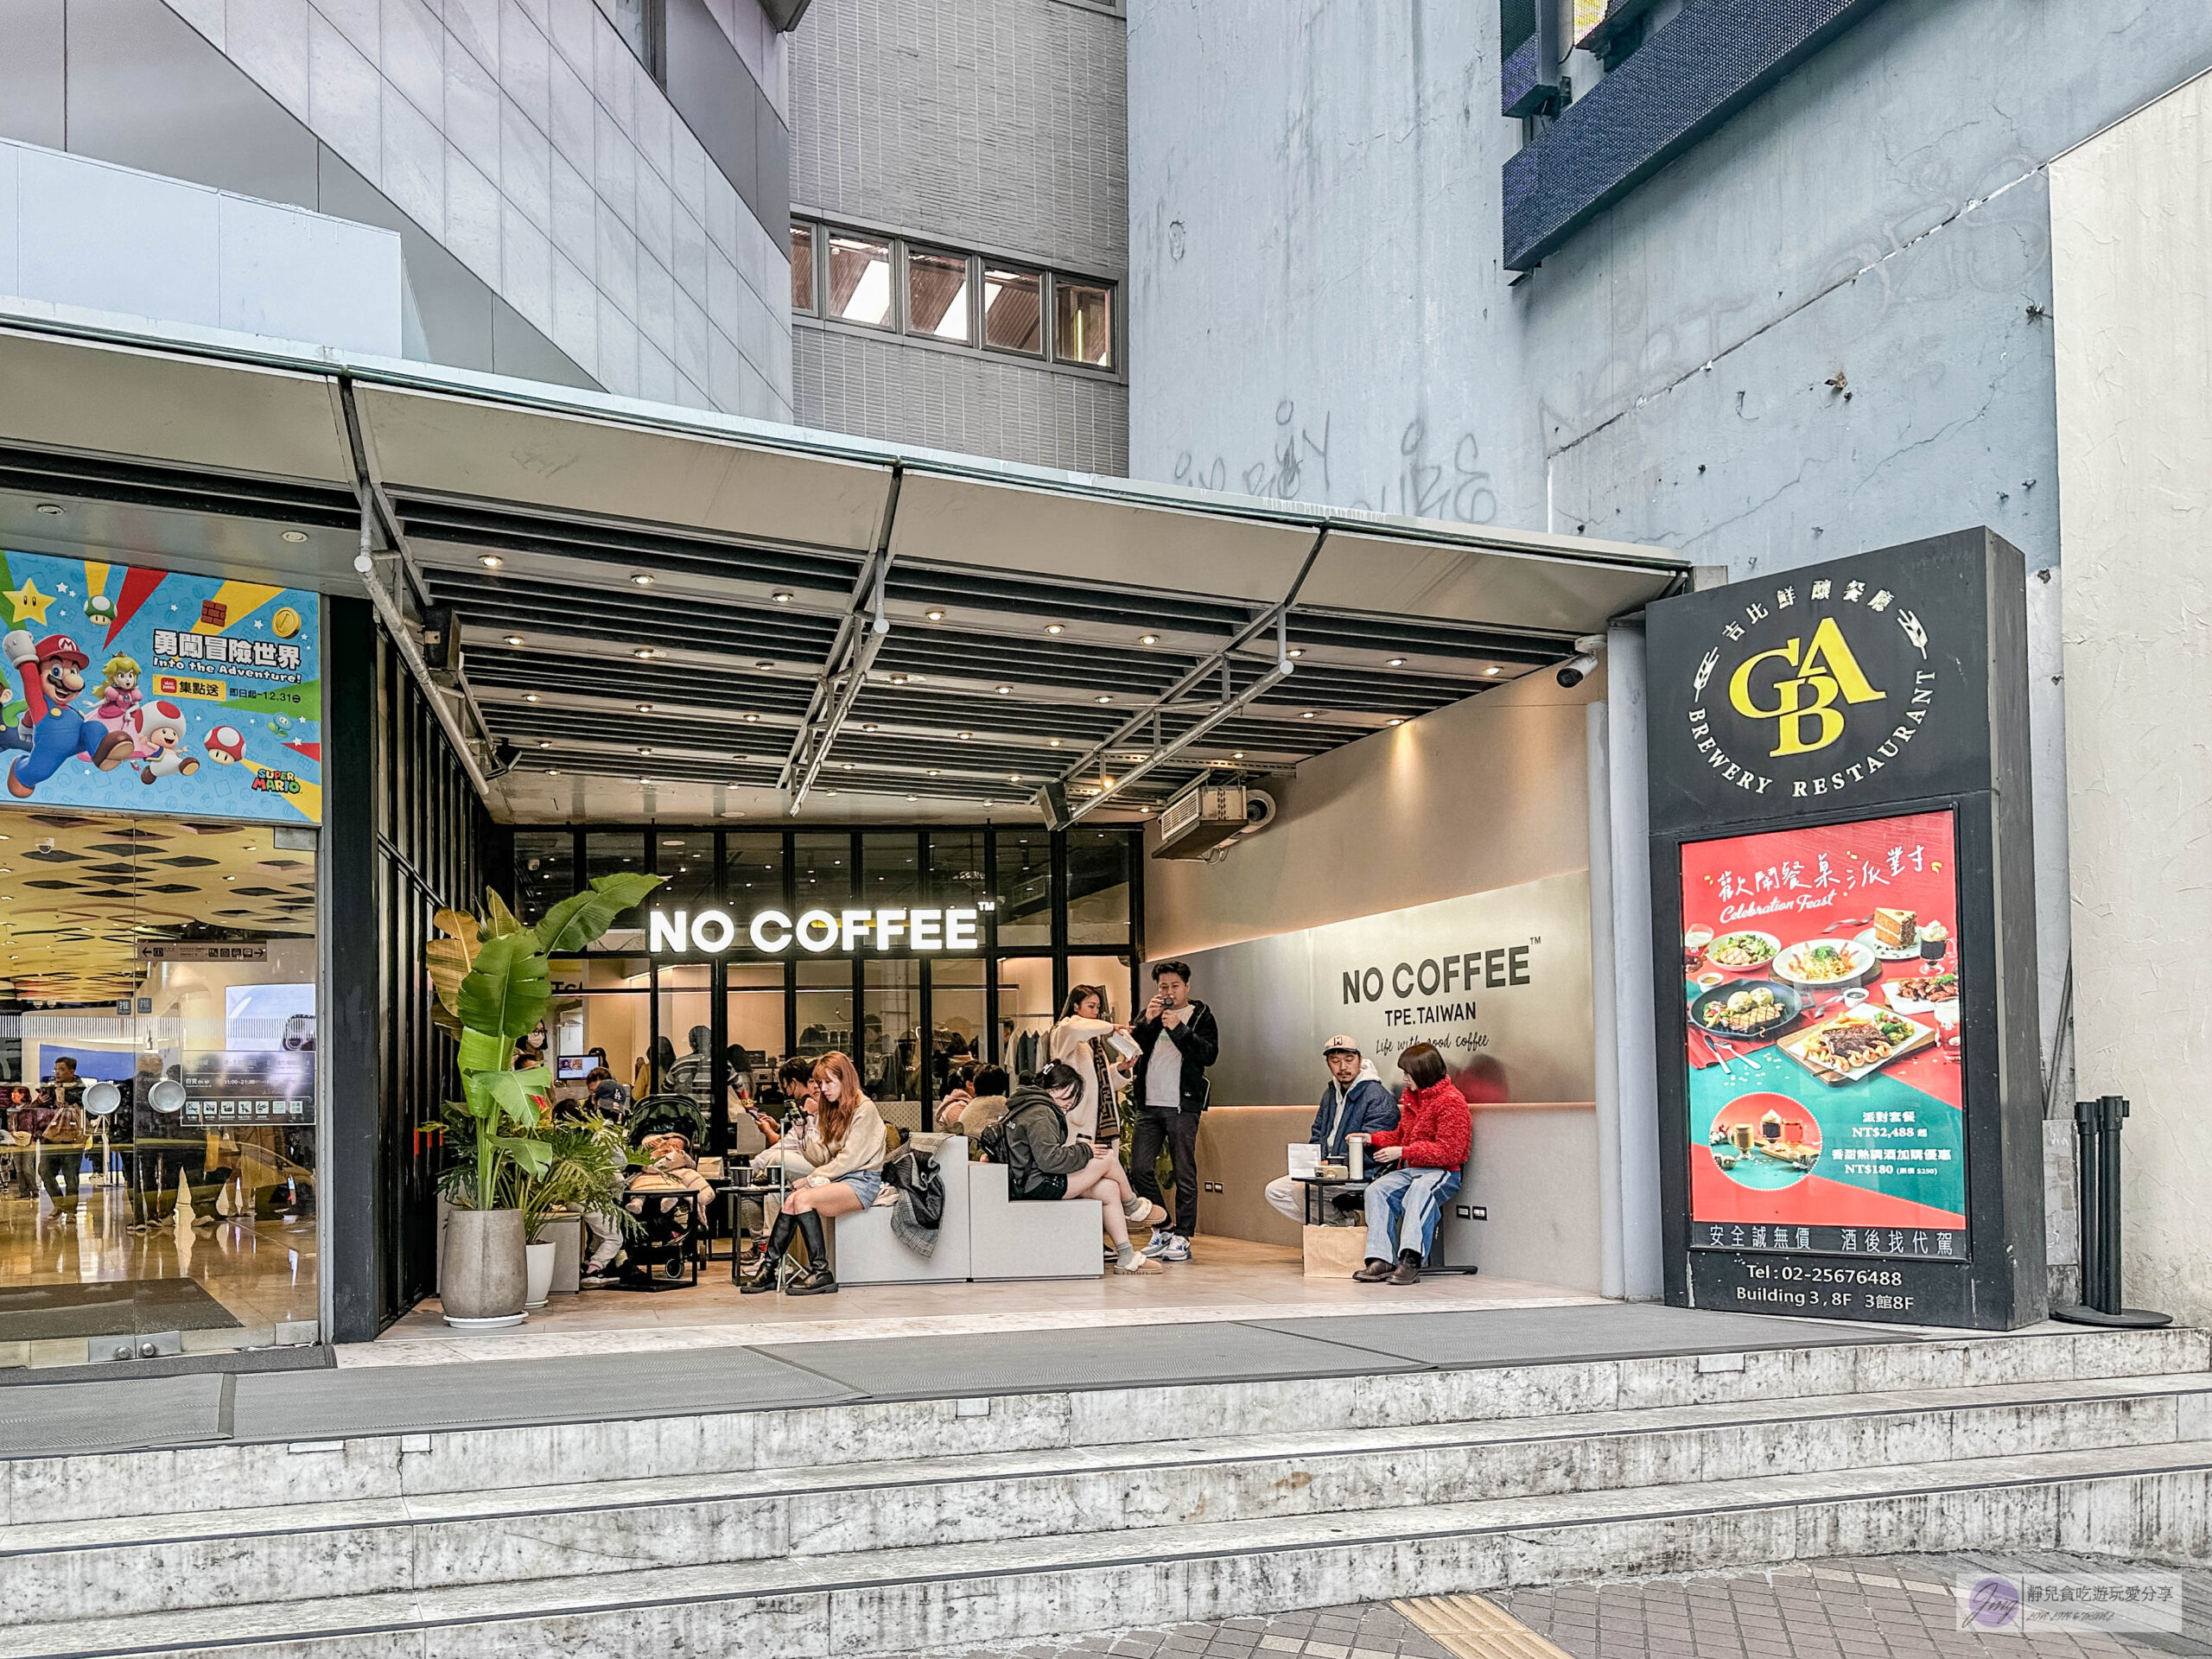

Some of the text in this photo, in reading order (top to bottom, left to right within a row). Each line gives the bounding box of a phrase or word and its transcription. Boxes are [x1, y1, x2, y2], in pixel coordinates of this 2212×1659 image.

[1722, 579, 1895, 642] 吉比鮮釀餐廳
[153, 629, 302, 671] 勇闖冒險世界
[153, 658, 302, 684] Into the Adventure!
[180, 681, 219, 697] 集點送
[1688, 670, 1936, 798] BREWERY RESTAURANT
[251, 778, 301, 794] MARIO
[257, 768, 296, 781] SUPER
[1719, 890, 1837, 924] Celebration Feast
[650, 910, 735, 953] NO
[750, 909, 978, 952] COFFEE
[1343, 966, 1384, 1005] NO
[1392, 945, 1530, 999] COFFEE
[118, 1000, 130, 1010] 推
[1384, 1001, 1477, 1027] TPE.TAIWAN
[1333, 1037, 1344, 1046] M
[1376, 1037, 1394, 1057] Life
[1455, 1031, 1490, 1052] coffee
[1862, 1110, 1916, 1123] 派對套餐
[1852, 1127, 1915, 1139] NT$2,488
[1831, 1148, 1952, 1161] 香甜熱調酒加購優惠
[1844, 1164, 1894, 1175] NT$180
[1709, 1224, 1954, 1256] 安全誠無價 酒後找代駕
[1781, 1265, 1903, 1287] 02-25676488
[1736, 1287, 1805, 1306] Building
[1831, 1292, 1853, 1307] 8F
[1864, 1294, 1915, 1311] 3館8F
